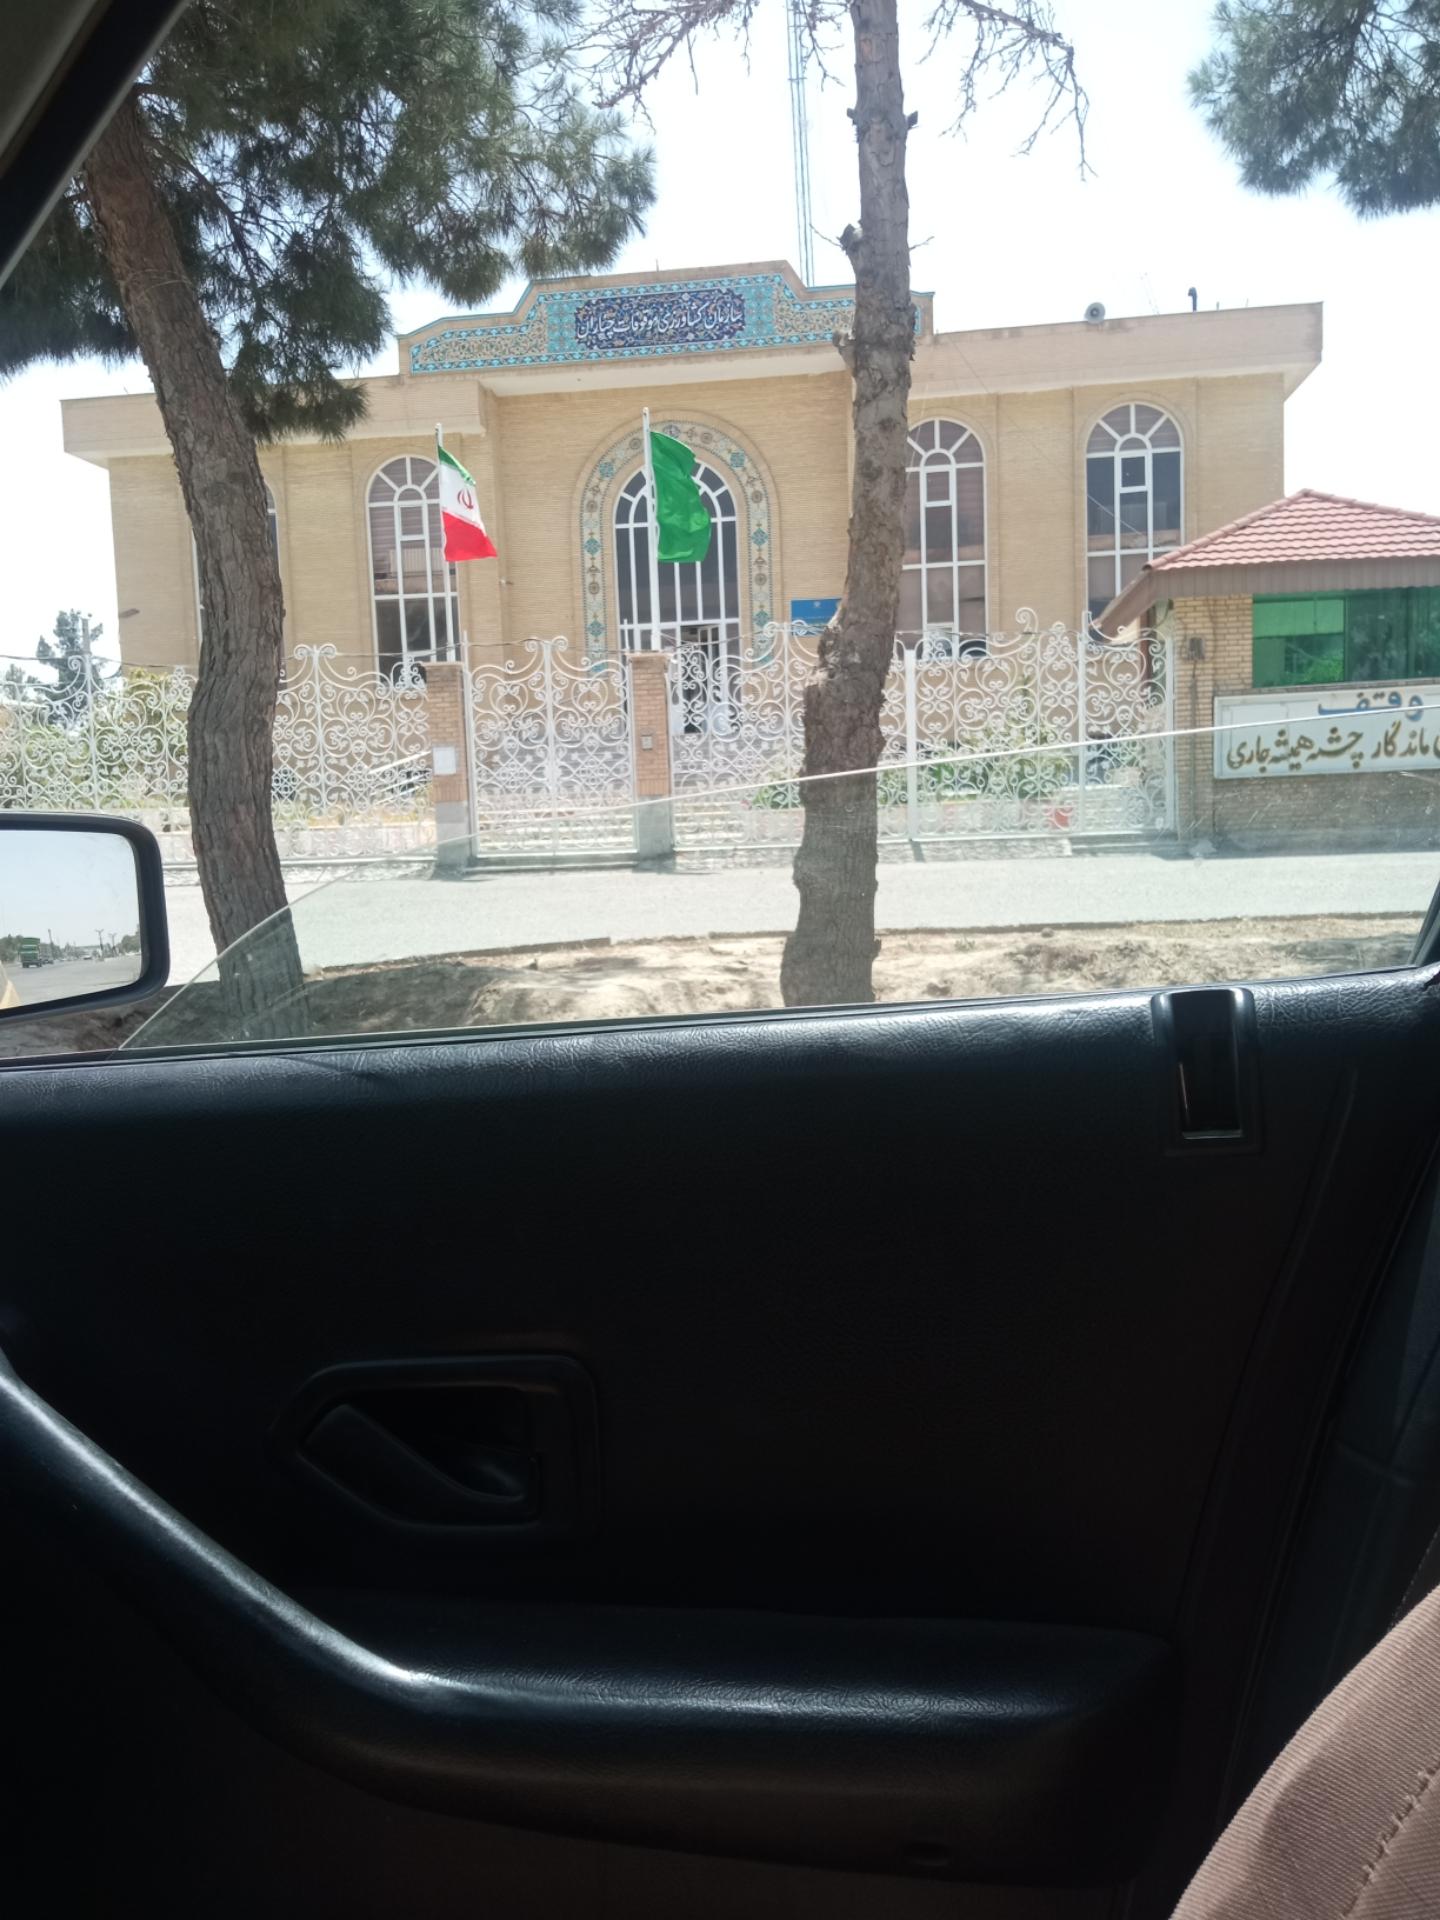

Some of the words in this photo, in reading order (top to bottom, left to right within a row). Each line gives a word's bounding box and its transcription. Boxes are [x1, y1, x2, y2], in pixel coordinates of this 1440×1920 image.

[612, 309, 659, 333] موقوفات
[704, 304, 743, 329] سازمان
[1317, 690, 1424, 721] وقف
[1226, 735, 1272, 773] جاری
[1269, 729, 1315, 770] همیشه
[1306, 727, 1364, 769] چشمه
[1371, 720, 1430, 759] ماندگار
